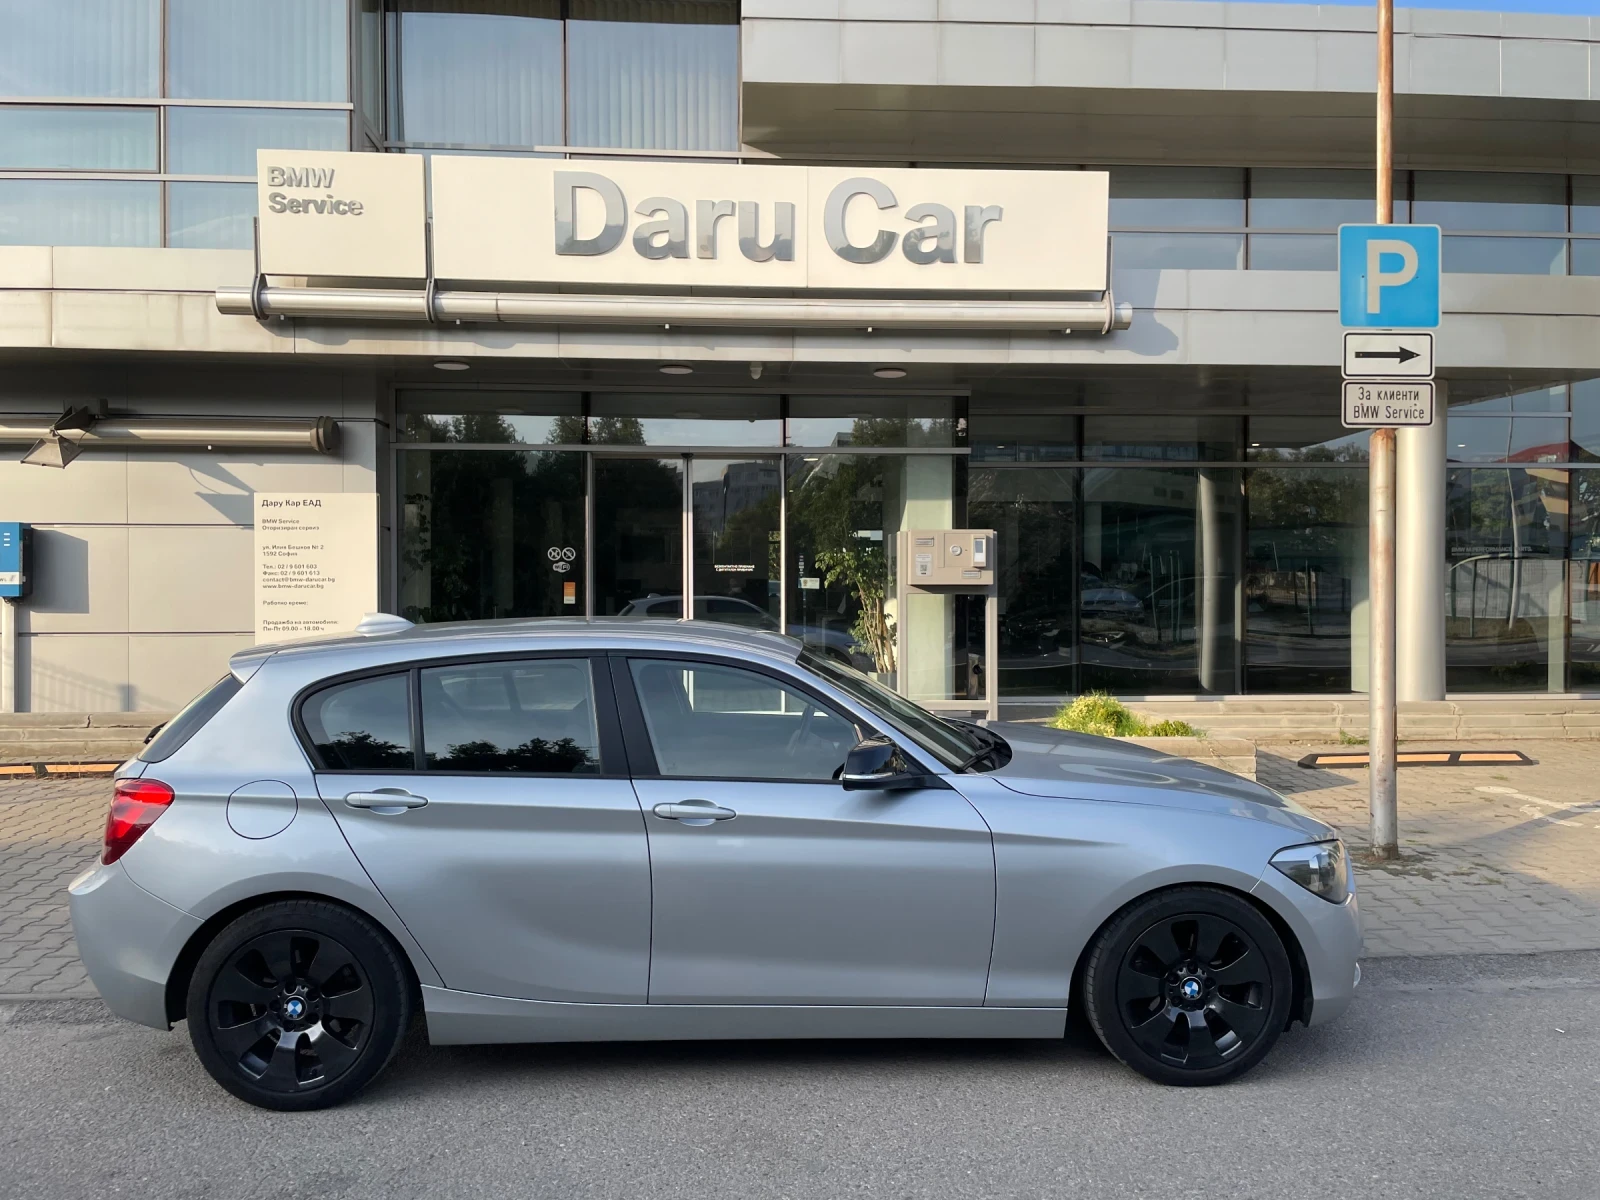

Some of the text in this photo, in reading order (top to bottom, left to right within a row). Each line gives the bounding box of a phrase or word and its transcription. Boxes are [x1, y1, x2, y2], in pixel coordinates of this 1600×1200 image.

[267, 165, 335, 189] BMW
[268, 192, 364, 216] Service
[553, 170, 1004, 265] Daru Car
[1366, 239, 1419, 314] P
[1358, 386, 1420, 400] За клиенти
[1353, 405, 1425, 419] BMW Service
[262, 499, 322, 508] Дару Кар ЕАД
